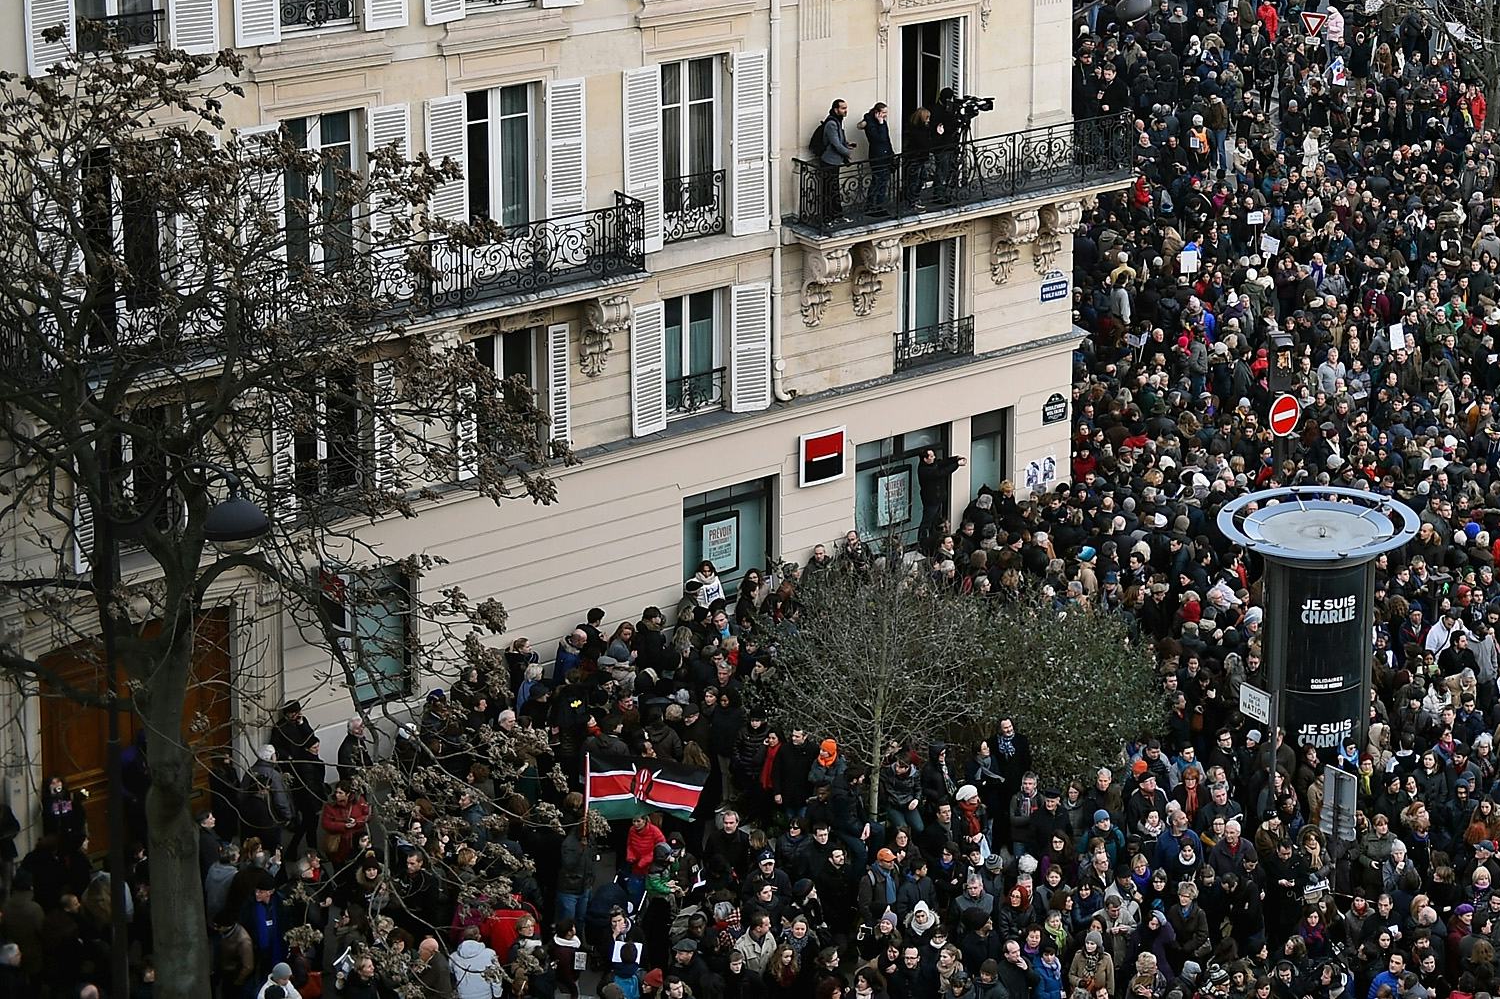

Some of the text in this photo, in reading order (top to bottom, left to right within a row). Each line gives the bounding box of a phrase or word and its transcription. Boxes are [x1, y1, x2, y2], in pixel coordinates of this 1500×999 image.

[1042, 283, 1067, 293] BOULEVARD
[1042, 290, 1067, 299] VOLTAIRE
[709, 524, 732, 540] PRÉVOIR
[1301, 595, 1356, 610] JE SUIS
[1301, 605, 1356, 624] CHARLIE
[1249, 693, 1261, 702] PLACE
[1243, 701, 1266, 717] NATION
[1298, 719, 1352, 734] JE SUIS
